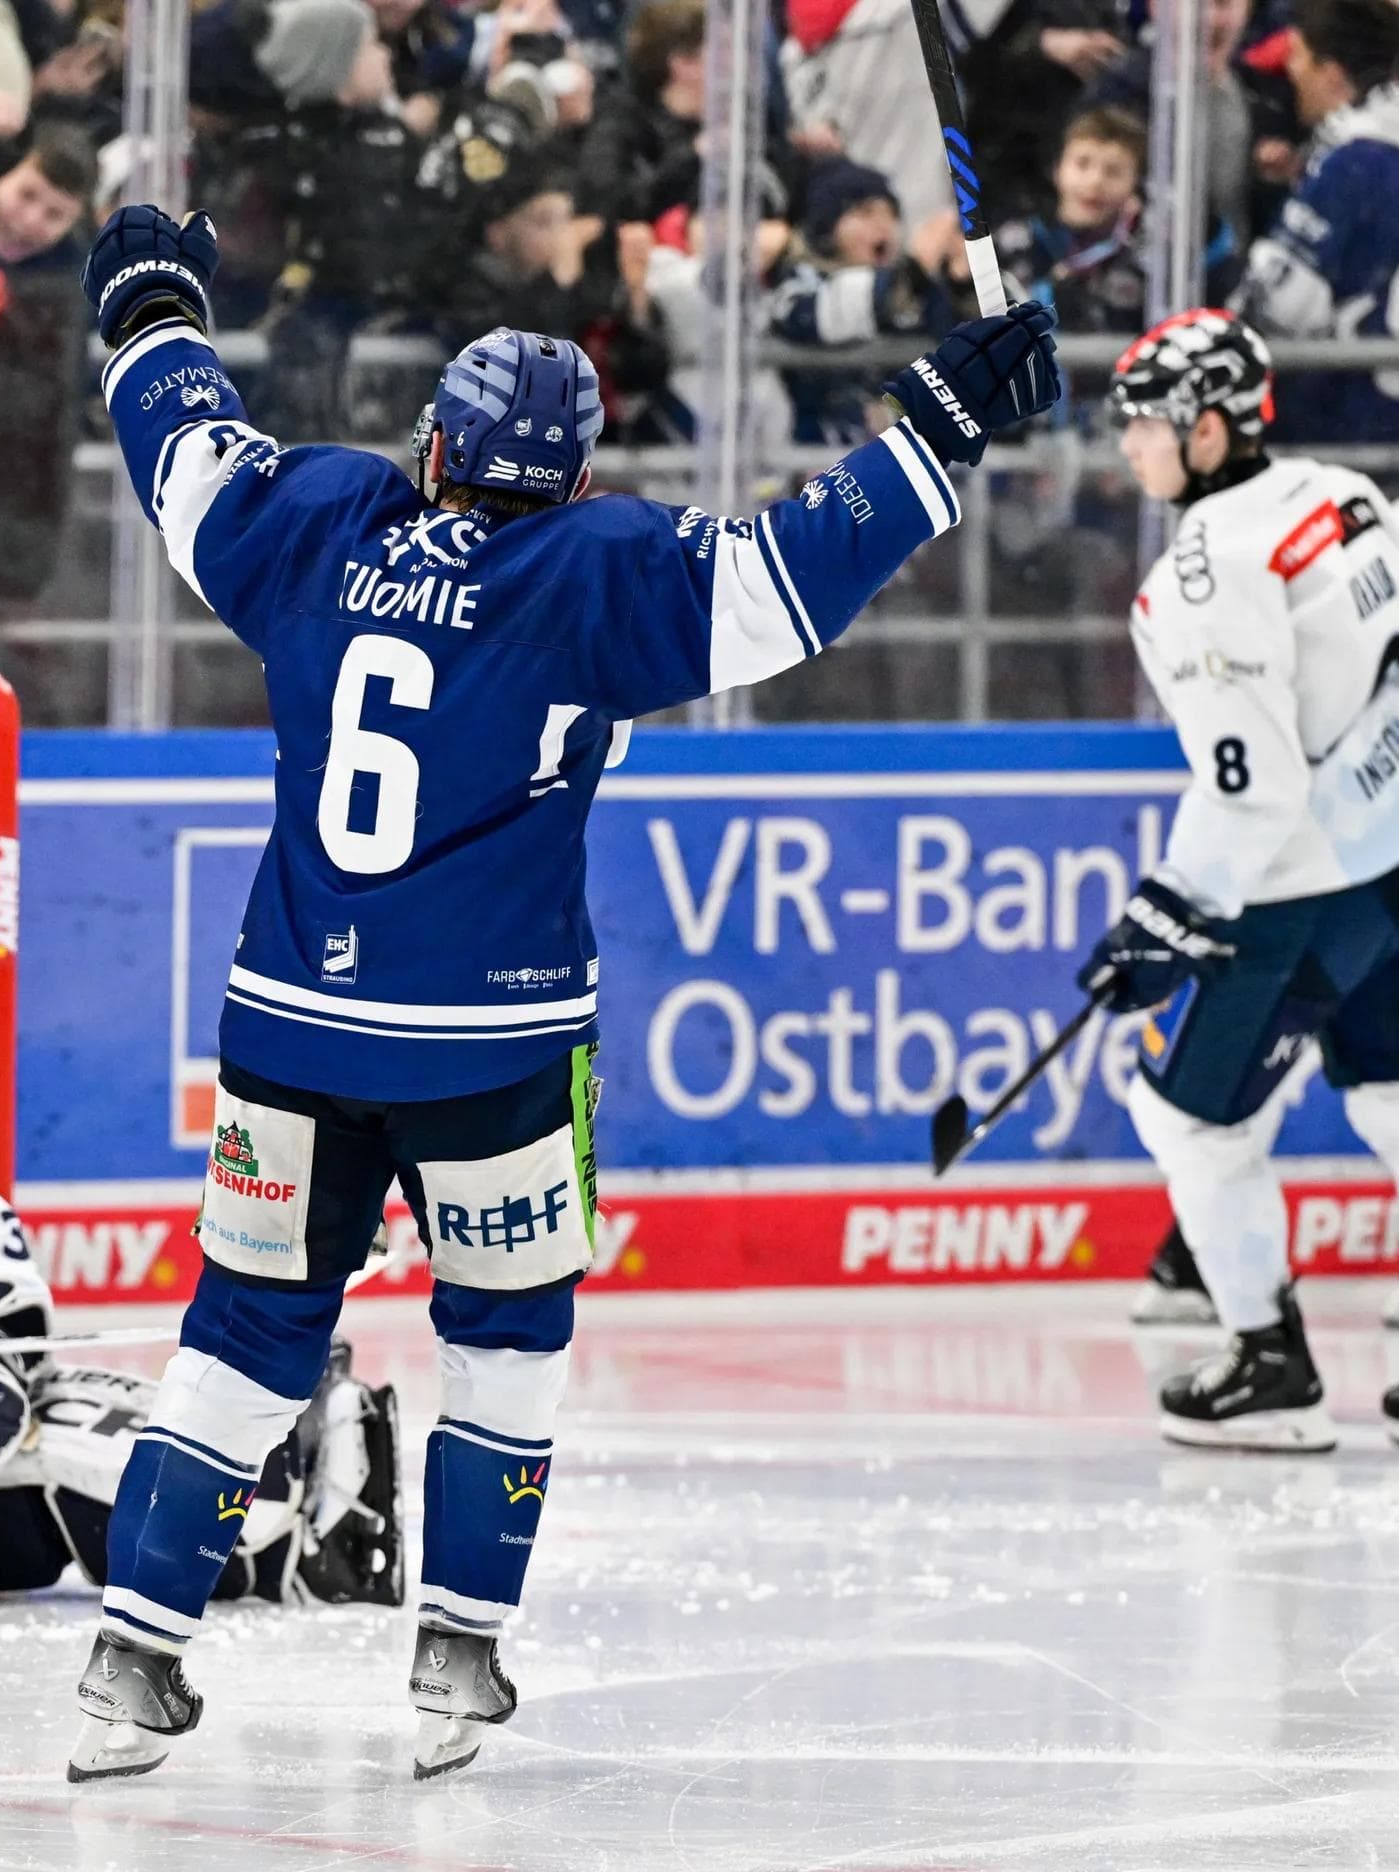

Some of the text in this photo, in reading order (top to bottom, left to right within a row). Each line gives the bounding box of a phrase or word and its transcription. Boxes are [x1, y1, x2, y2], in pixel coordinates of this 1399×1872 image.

[99, 259, 206, 317] HERWOO
[140, 366, 239, 412] DEEMATEC
[910, 356, 982, 439] SHERW
[456, 431, 465, 447] 6
[522, 478, 560, 492] GRUPPE
[525, 465, 563, 482] KOCH
[696, 520, 718, 560] RICHT
[339, 560, 482, 630] TUOMIE
[319, 633, 434, 874] 6
[1213, 736, 1250, 794] 8
[327, 938, 349, 952] EHC
[487, 966, 571, 983] FARB SCHLIFF
[647, 968, 1146, 1149] Ostbaye
[0, 1211, 33, 1260] 3
[219, 1226, 236, 1243] aus
